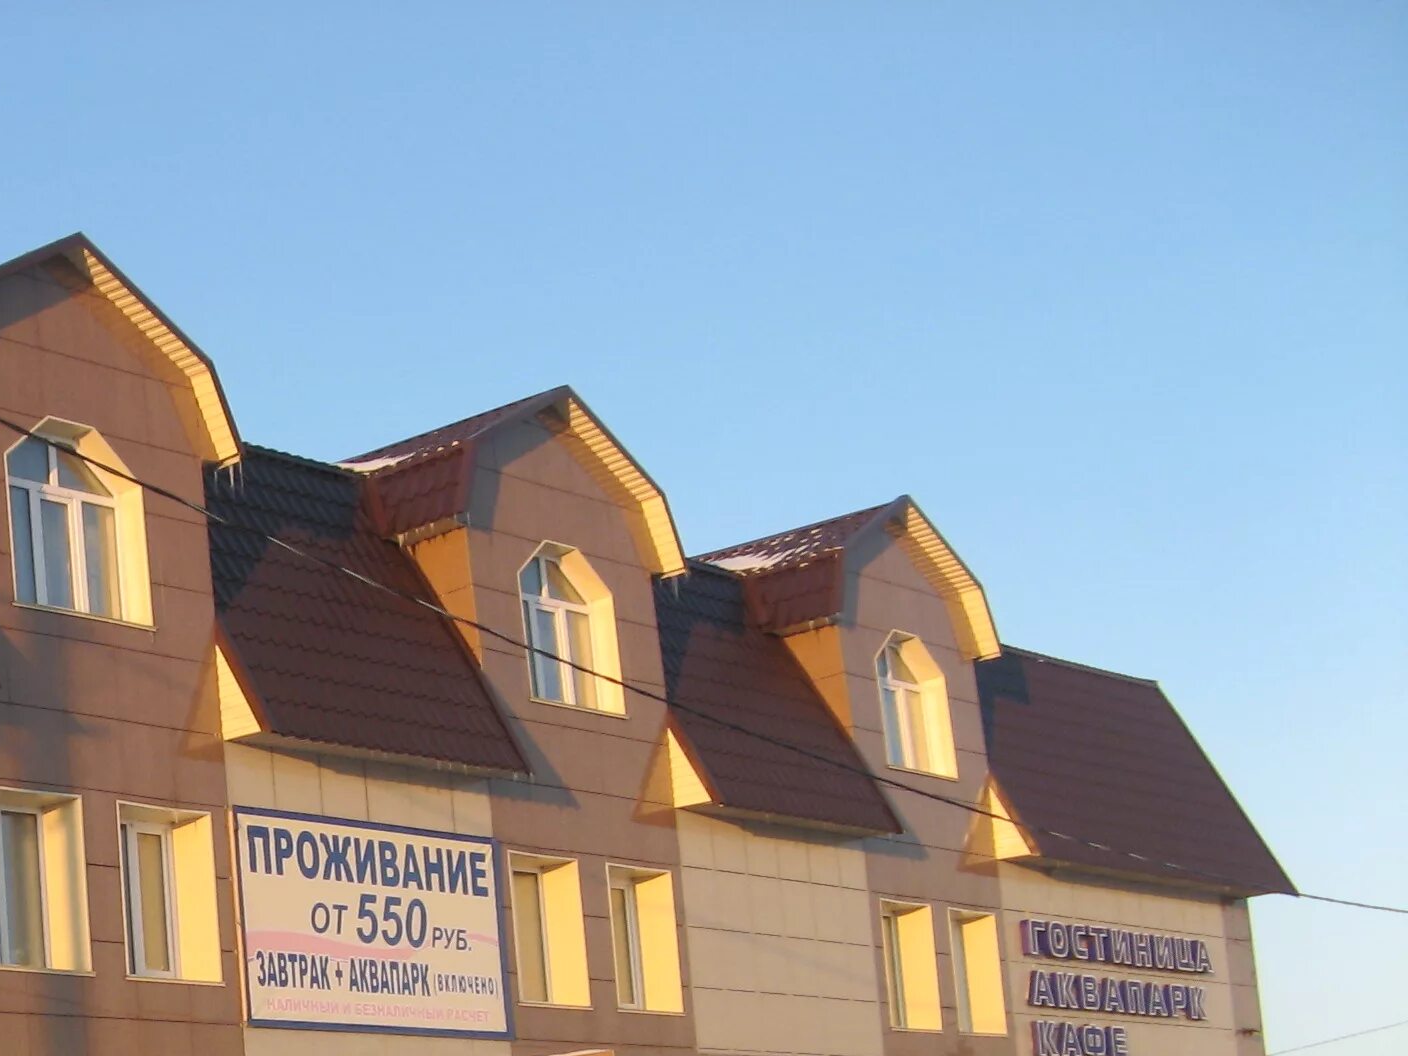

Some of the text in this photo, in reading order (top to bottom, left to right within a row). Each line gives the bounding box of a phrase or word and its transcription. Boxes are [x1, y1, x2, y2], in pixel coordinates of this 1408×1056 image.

[247, 825, 490, 898] ПРОЖИВАНИЕ
[310, 893, 472, 952] ОТ 550 РУБ.
[1020, 919, 1215, 974] ГОСТИНИЦА
[255, 951, 331, 990] ЗАВТРАК
[349, 958, 431, 997] АКВАПАРК
[433, 973, 499, 999] (ВКЛЮЧЕНО)
[1028, 969, 1208, 1020] АКВАПАРК
